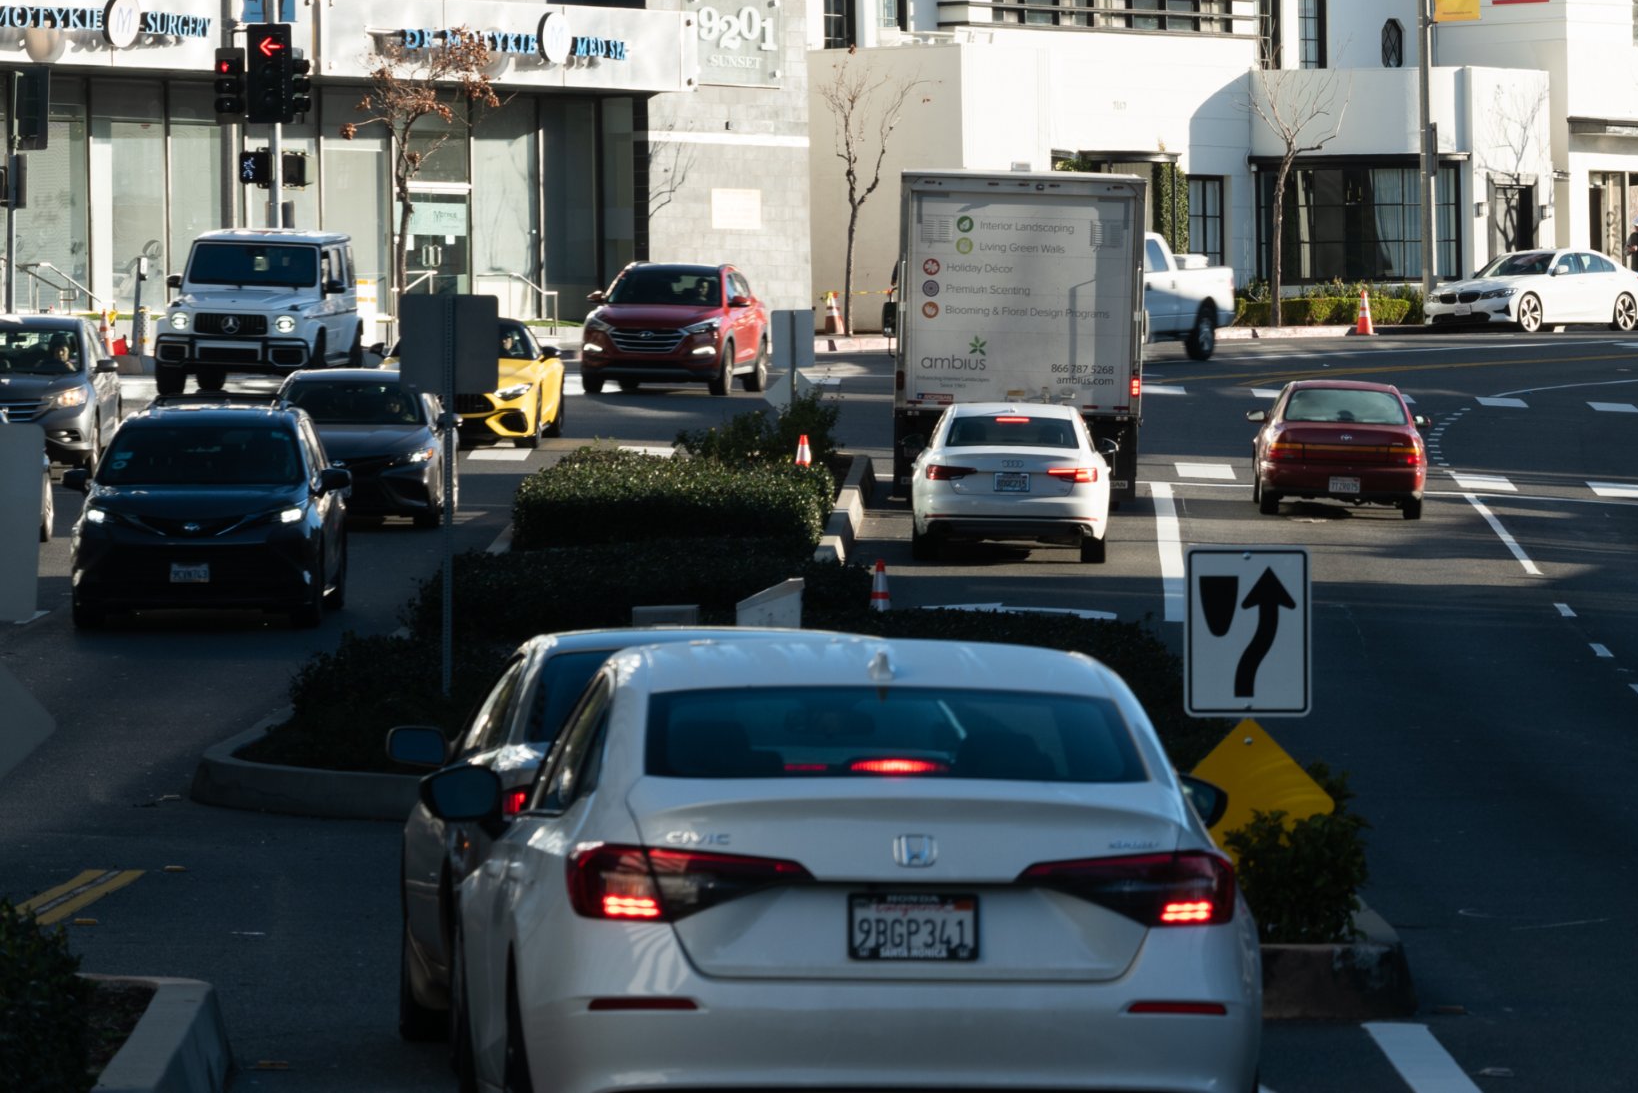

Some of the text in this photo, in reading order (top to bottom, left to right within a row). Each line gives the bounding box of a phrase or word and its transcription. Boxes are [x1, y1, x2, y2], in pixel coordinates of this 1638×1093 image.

[146, 10, 212, 38] SURGERY
[698, 6, 778, 51] 9201
[576, 37, 609, 57] MED
[609, 40, 629, 61] SPA
[710, 54, 761, 68] SUNSET
[980, 221, 1075, 235] Interior Landscaping
[979, 243, 1066, 254] Living Green Walls
[946, 263, 1014, 274] Holiday Décor
[945, 284, 1031, 297] Premium Scenting
[945, 305, 1110, 320] Blooming & Floral Design Programs
[921, 355, 987, 372] ambius
[1051, 363, 1114, 375] 866 787 5268
[1056, 375, 1114, 386] ambius.com
[666, 830, 731, 846] CIVIC
[886, 895, 939, 904] HONDA
[857, 918, 968, 948] 9BGP341
[879, 948, 947, 958] SANTA MONICA
